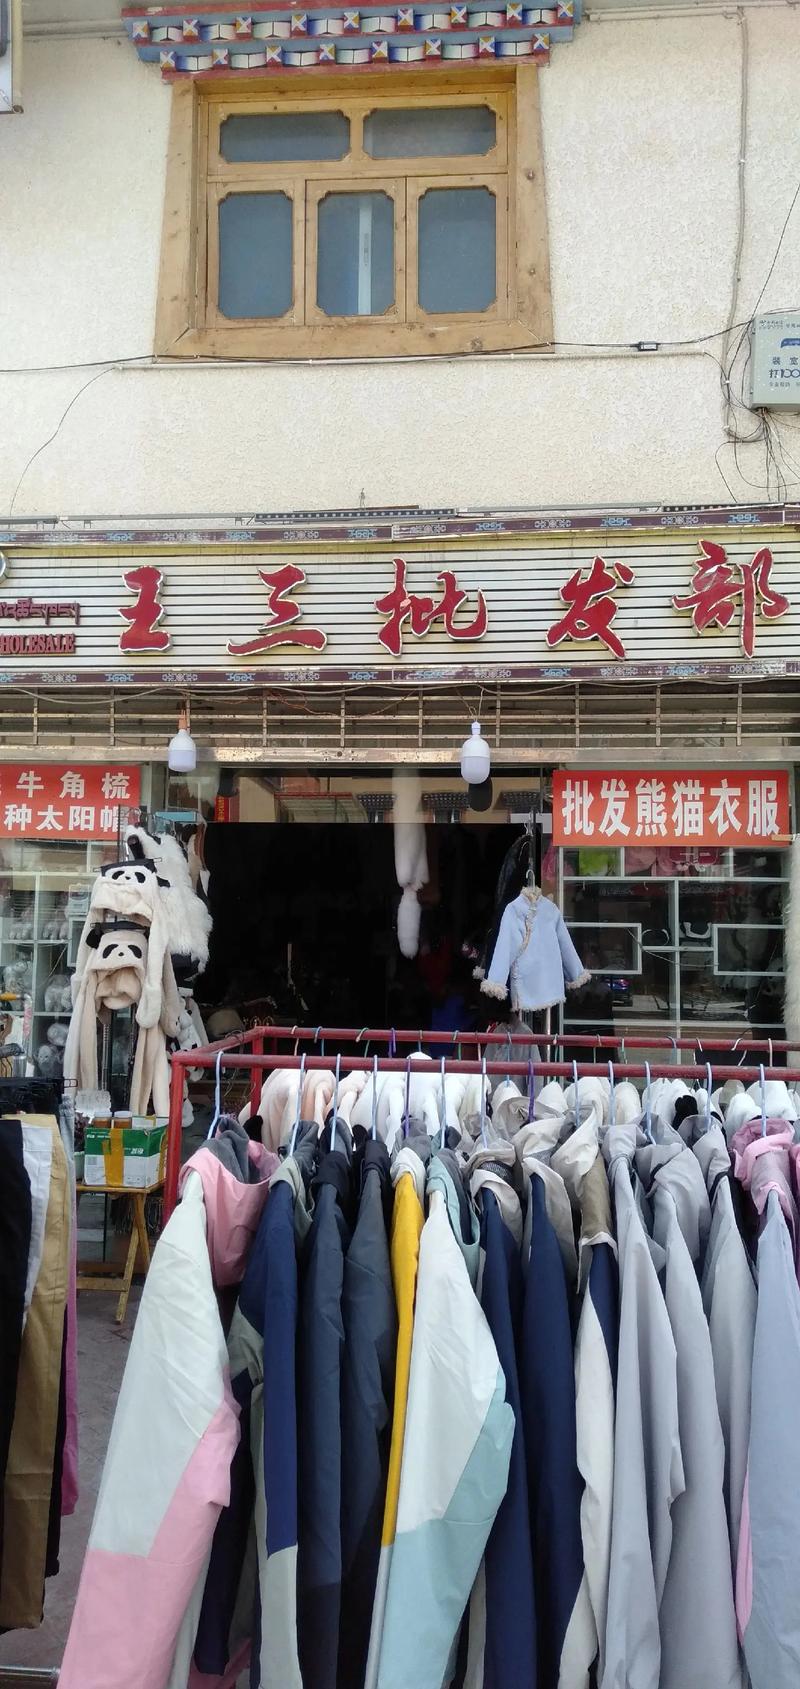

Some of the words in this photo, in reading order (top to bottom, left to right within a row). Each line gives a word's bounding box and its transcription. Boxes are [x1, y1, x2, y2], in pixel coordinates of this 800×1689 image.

[117, 539, 790, 660] 王三批发部
[0, 770, 131, 800] 牛角梳
[561, 778, 780, 837] 批发熊猫衣服
